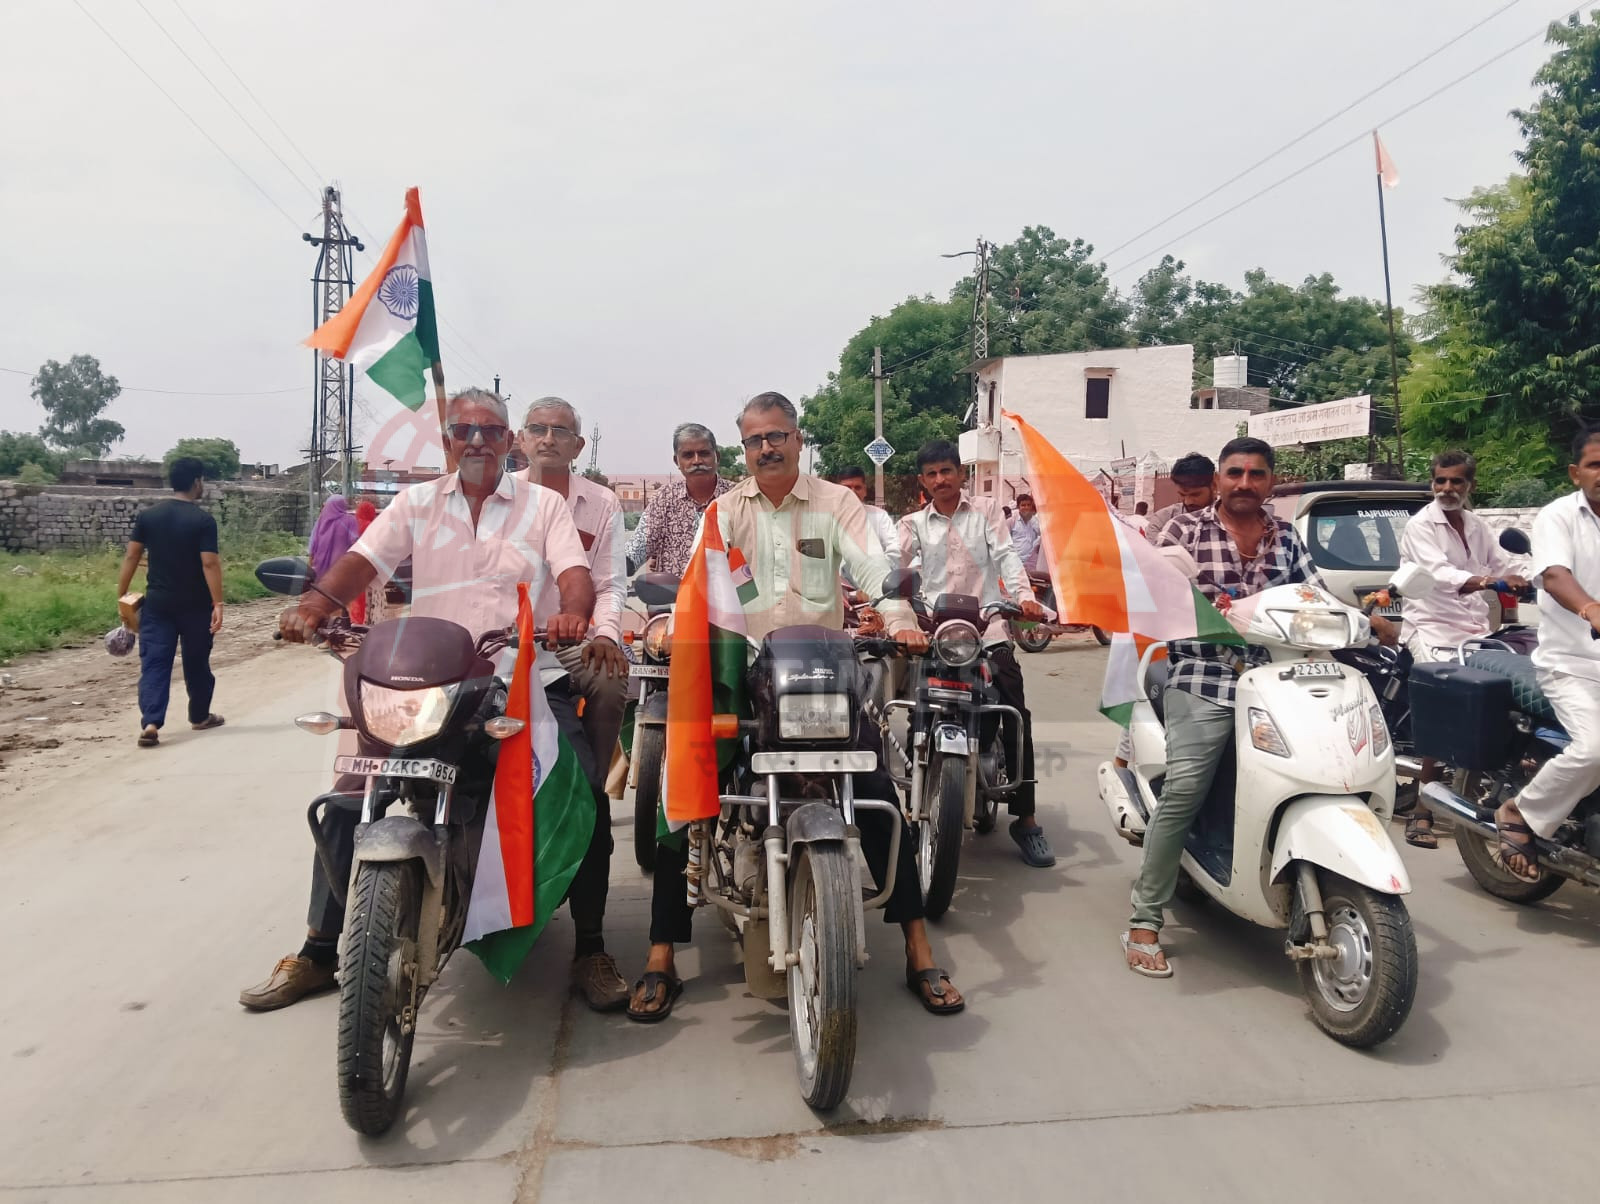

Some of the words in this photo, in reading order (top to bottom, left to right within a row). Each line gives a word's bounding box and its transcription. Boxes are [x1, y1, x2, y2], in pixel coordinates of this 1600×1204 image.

[1357, 509, 1410, 519] RAJPUROHIT
[352, 759, 373, 773] MH
[380, 760, 420, 774] 04KC
[430, 762, 454, 783] 1854
